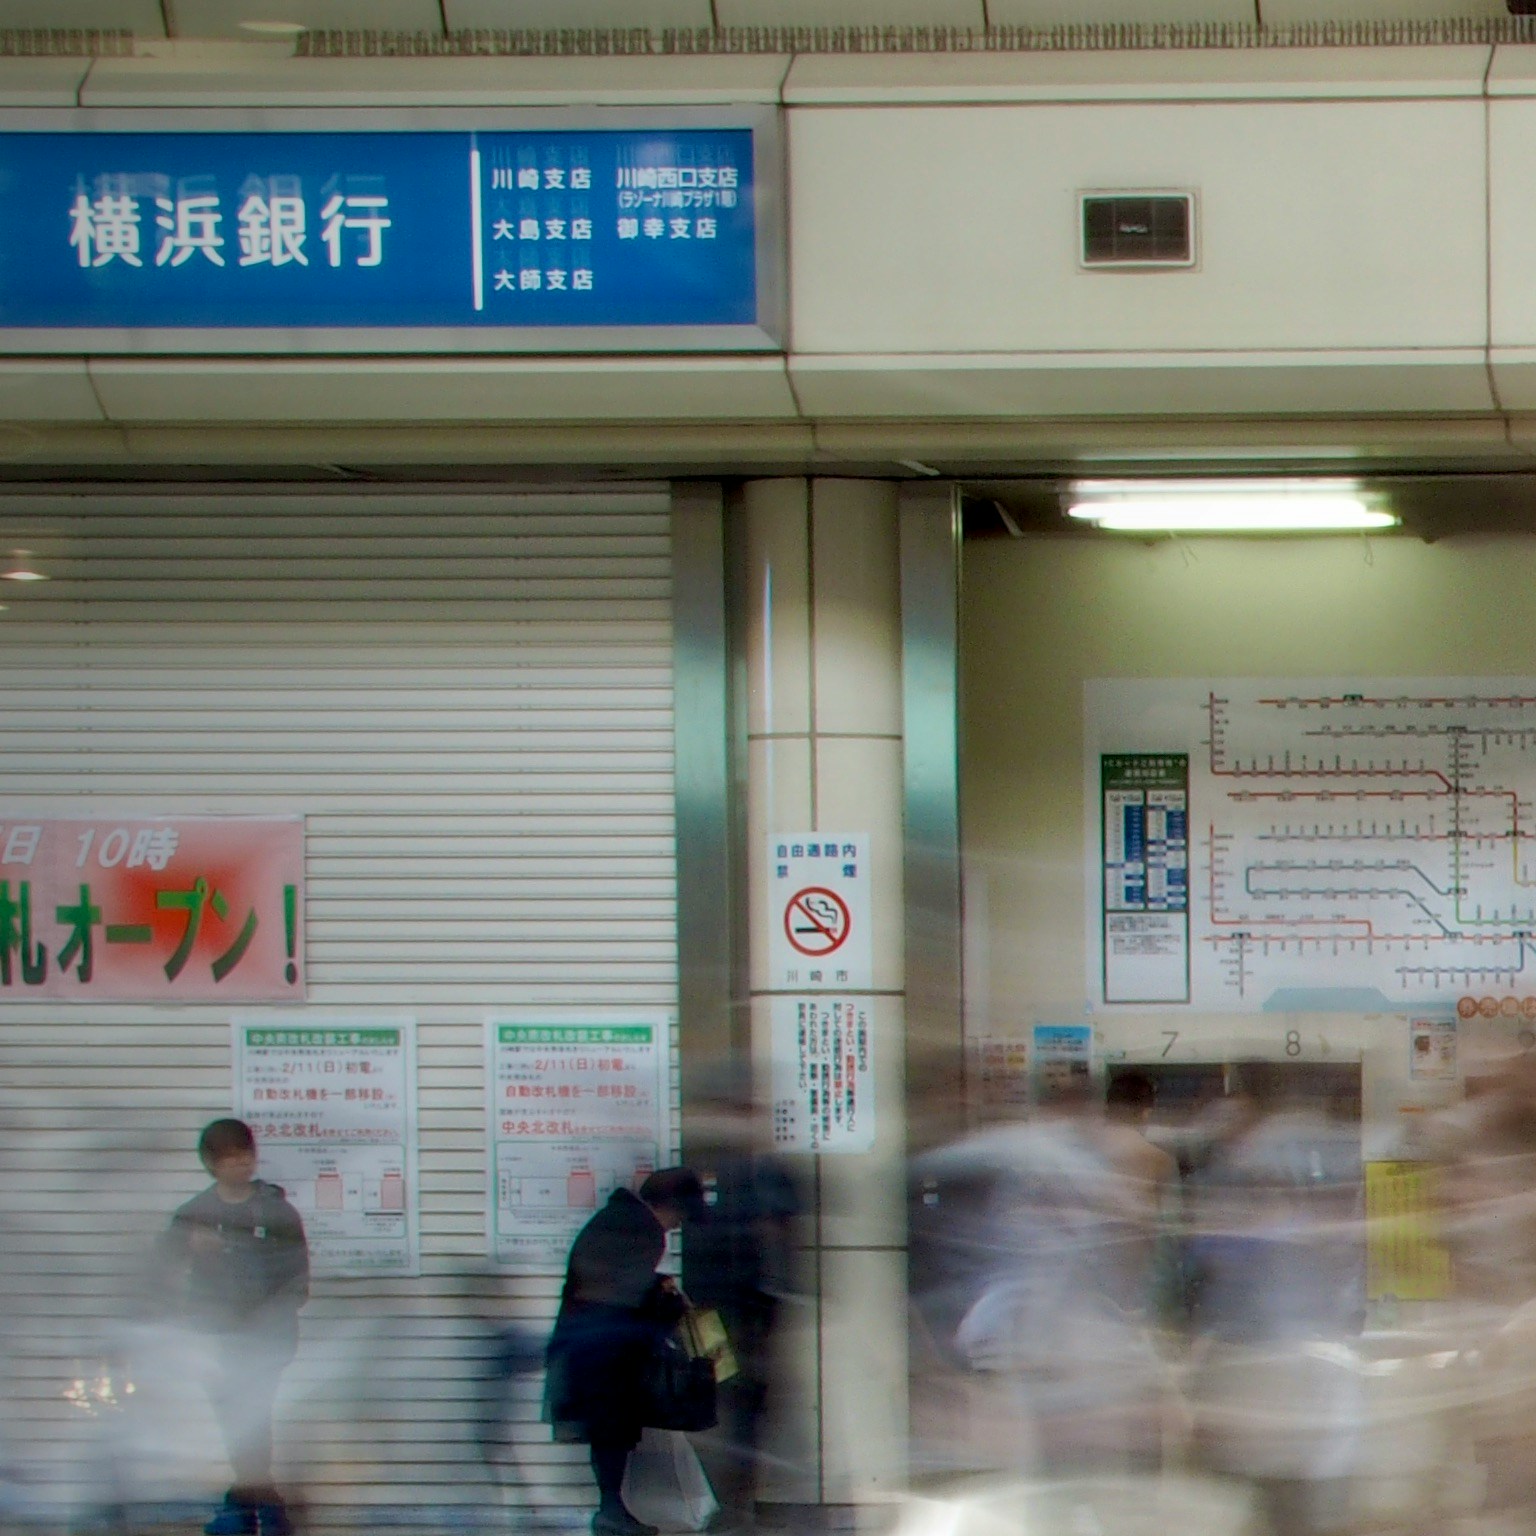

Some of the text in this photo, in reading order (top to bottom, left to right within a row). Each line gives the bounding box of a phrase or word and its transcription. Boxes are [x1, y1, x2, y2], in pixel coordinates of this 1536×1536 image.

[492, 168, 591, 189] 川崎支店
[616, 168, 738, 188] 川崎西口支店
[69, 195, 391, 269] 横浜銀行
[493, 218, 592, 239] 大島支店
[617, 218, 717, 239] 御幸支店
[494, 269, 593, 291] 大師支店
[0, 825, 179, 871] 日 10時
[1161, 1030, 1179, 1058] 7
[1285, 1030, 1301, 1057] 8
